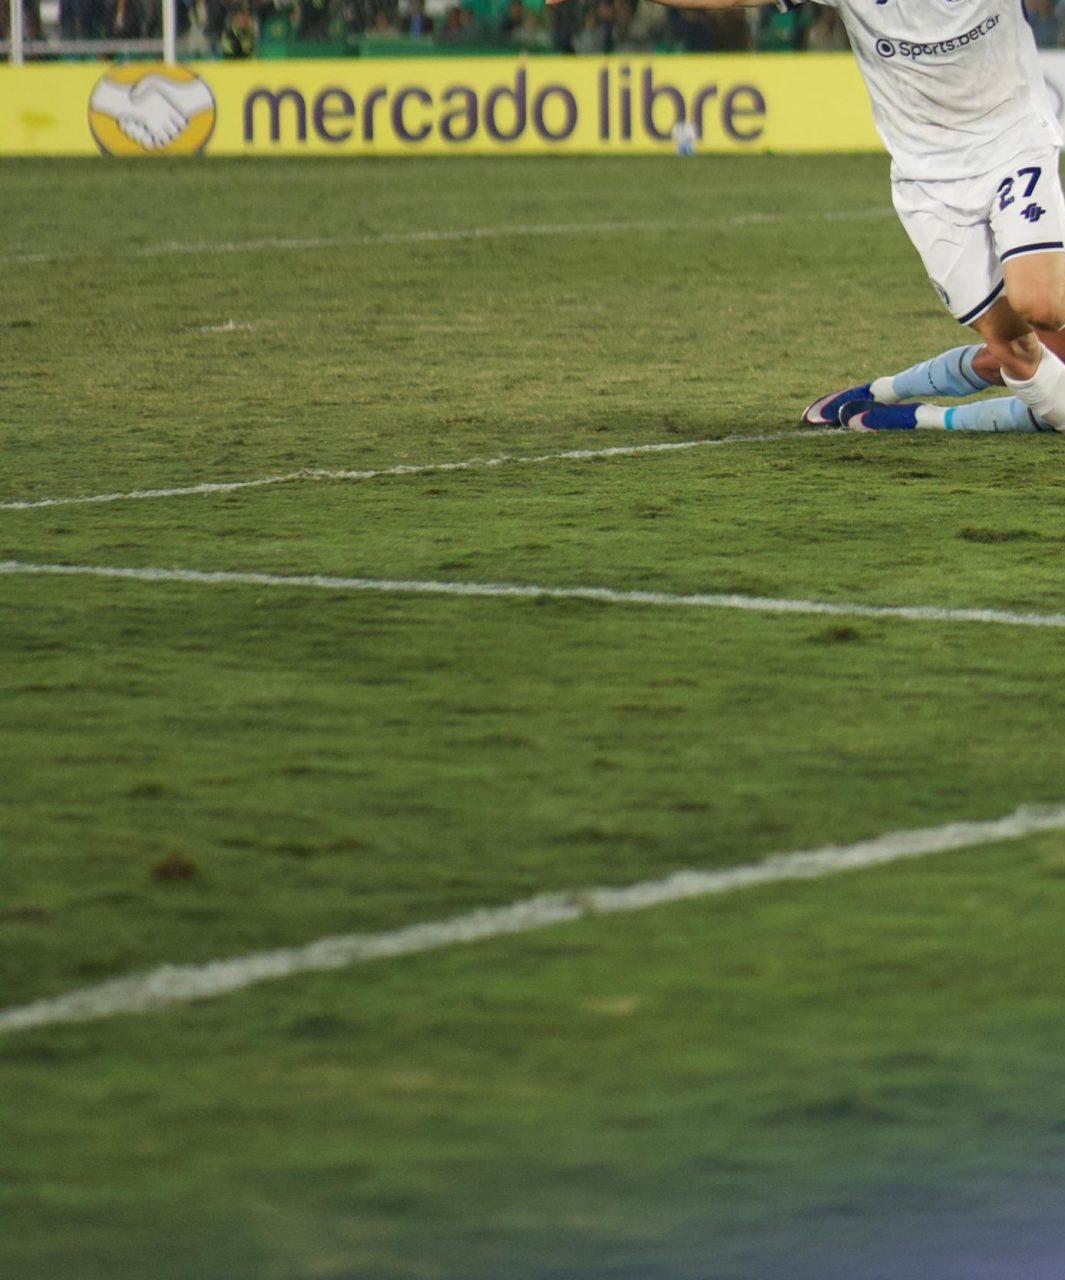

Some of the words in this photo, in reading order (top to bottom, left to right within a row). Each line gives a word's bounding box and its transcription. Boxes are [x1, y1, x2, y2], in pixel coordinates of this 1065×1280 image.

[898, 14, 1001, 60] Sports.bet.ar
[242, 66, 579, 144] mercado
[598, 66, 768, 143] libre
[996, 166, 1042, 211] 27
